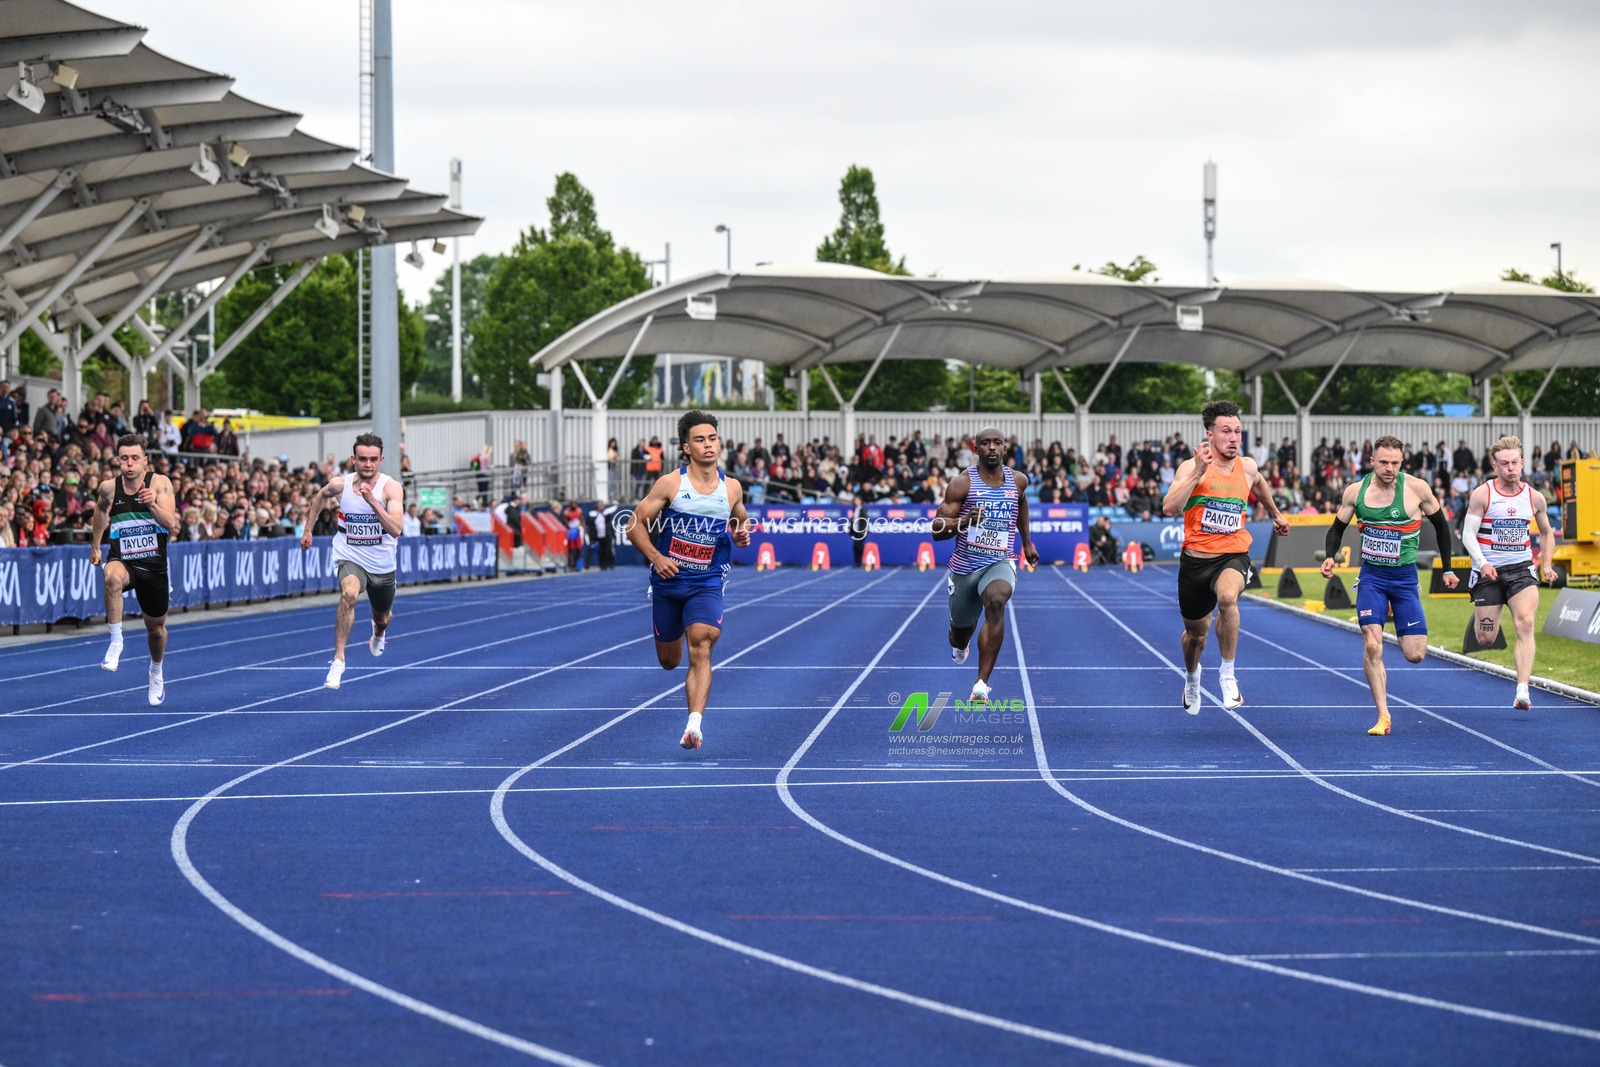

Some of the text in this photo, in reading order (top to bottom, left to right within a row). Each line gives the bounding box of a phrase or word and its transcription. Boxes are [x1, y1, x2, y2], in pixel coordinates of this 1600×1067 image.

[975, 501, 1014, 510] GREAT
[983, 510, 1012, 519] RITAIN
[1204, 510, 1240, 528] PANTON
[347, 525, 380, 536] MOSTYN
[981, 530, 999, 539] AMO
[1492, 528, 1527, 536] WINCHESTER
[122, 536, 155, 550] TAYLOR
[347, 538, 380, 546] MANCHESTER
[974, 535, 1002, 547] DADZIE
[1363, 537, 1399, 553] ROBERTSON
[1497, 535, 1523, 543] WRIGHT
[122, 550, 157, 560] MANCHESTER
[671, 541, 714, 559] HINCHLIFFE
[967, 545, 1005, 557] MANCHESTER
[816, 551, 825, 564] 7
[866, 550, 876, 565] 6
[920, 551, 930, 565] 5
[1077, 551, 1087, 566] 2
[1130, 551, 1137, 566] 1
[1361, 553, 1397, 564] MANCHESTER
